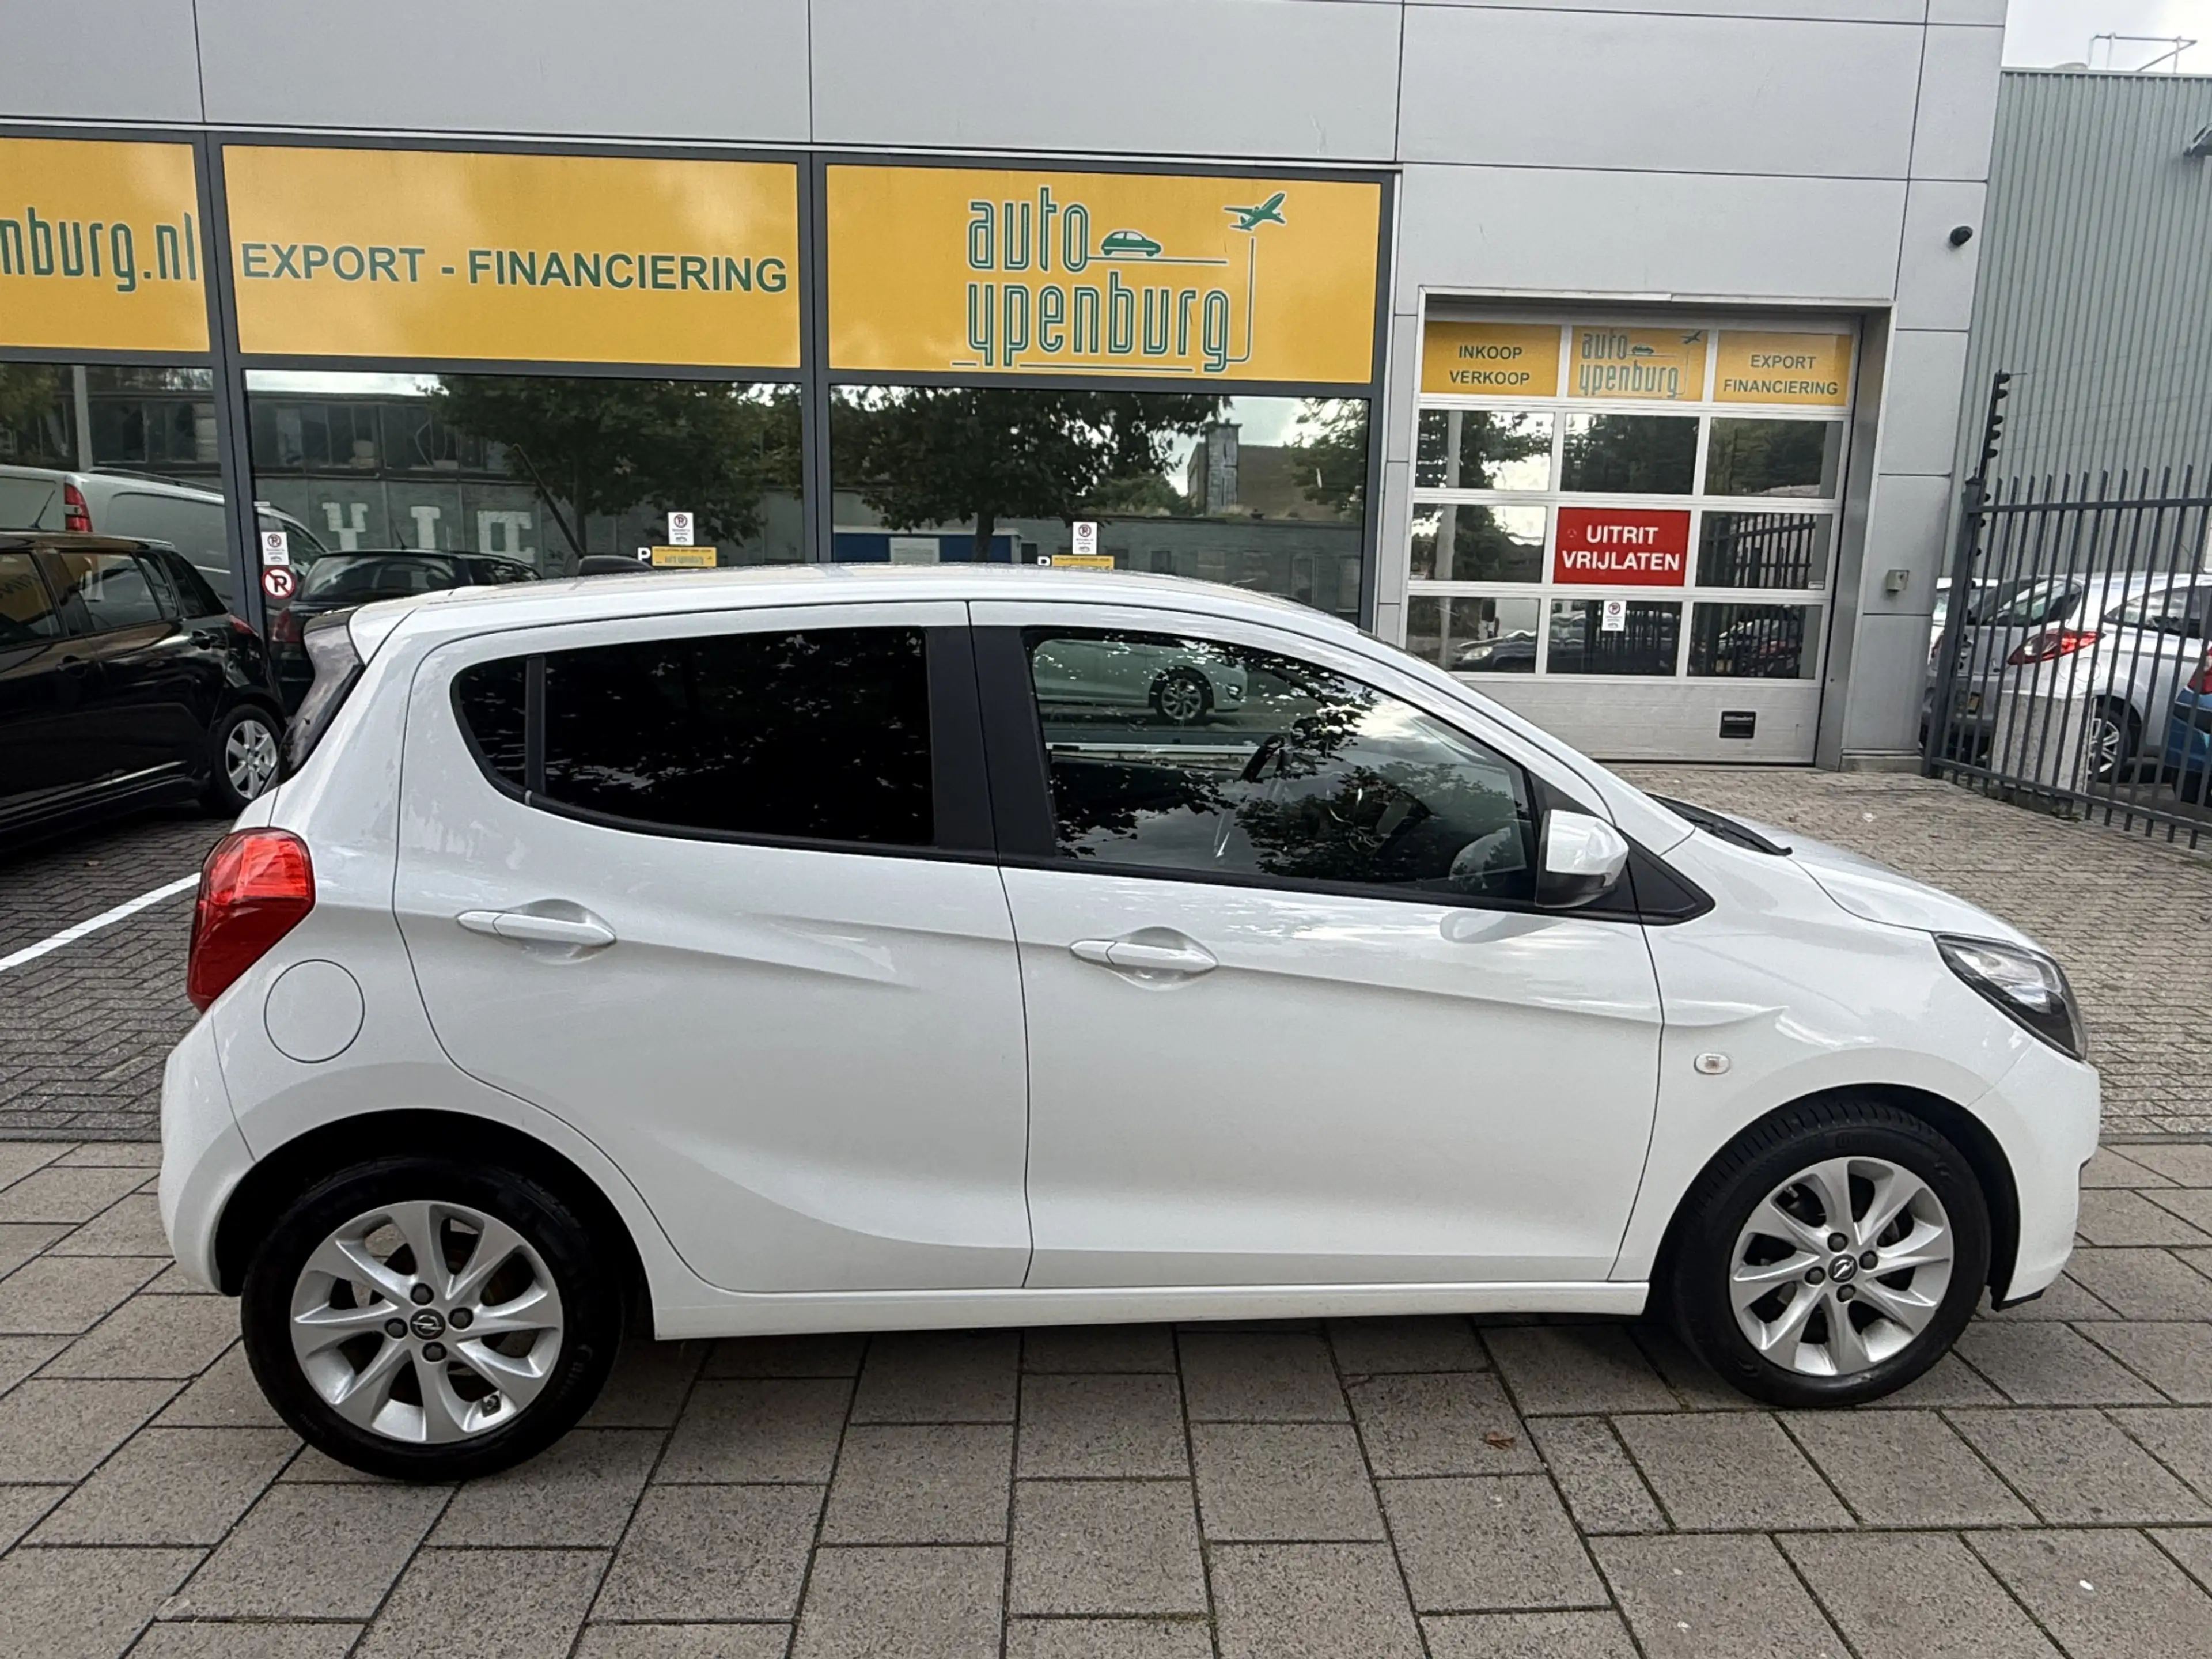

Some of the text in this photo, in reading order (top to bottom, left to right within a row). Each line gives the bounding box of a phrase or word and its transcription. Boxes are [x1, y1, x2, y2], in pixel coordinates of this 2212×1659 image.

[968, 187, 1089, 272] auto
[242, 243, 425, 282] EXPORT
[469, 249, 787, 293] FINANCIERING
[968, 271, 1229, 372] ypenburg
[1458, 344, 1523, 359] INKOOP
[1581, 329, 1627, 361] auto
[1750, 354, 1816, 370] EXPORT
[1449, 370, 1531, 385] VERKOOP
[1579, 359, 1679, 399] ypenburg
[1723, 378, 1838, 396] FINANCIERING
[1586, 525, 1659, 544] UITRIT
[1562, 550, 1680, 571] VRIJLATEN
